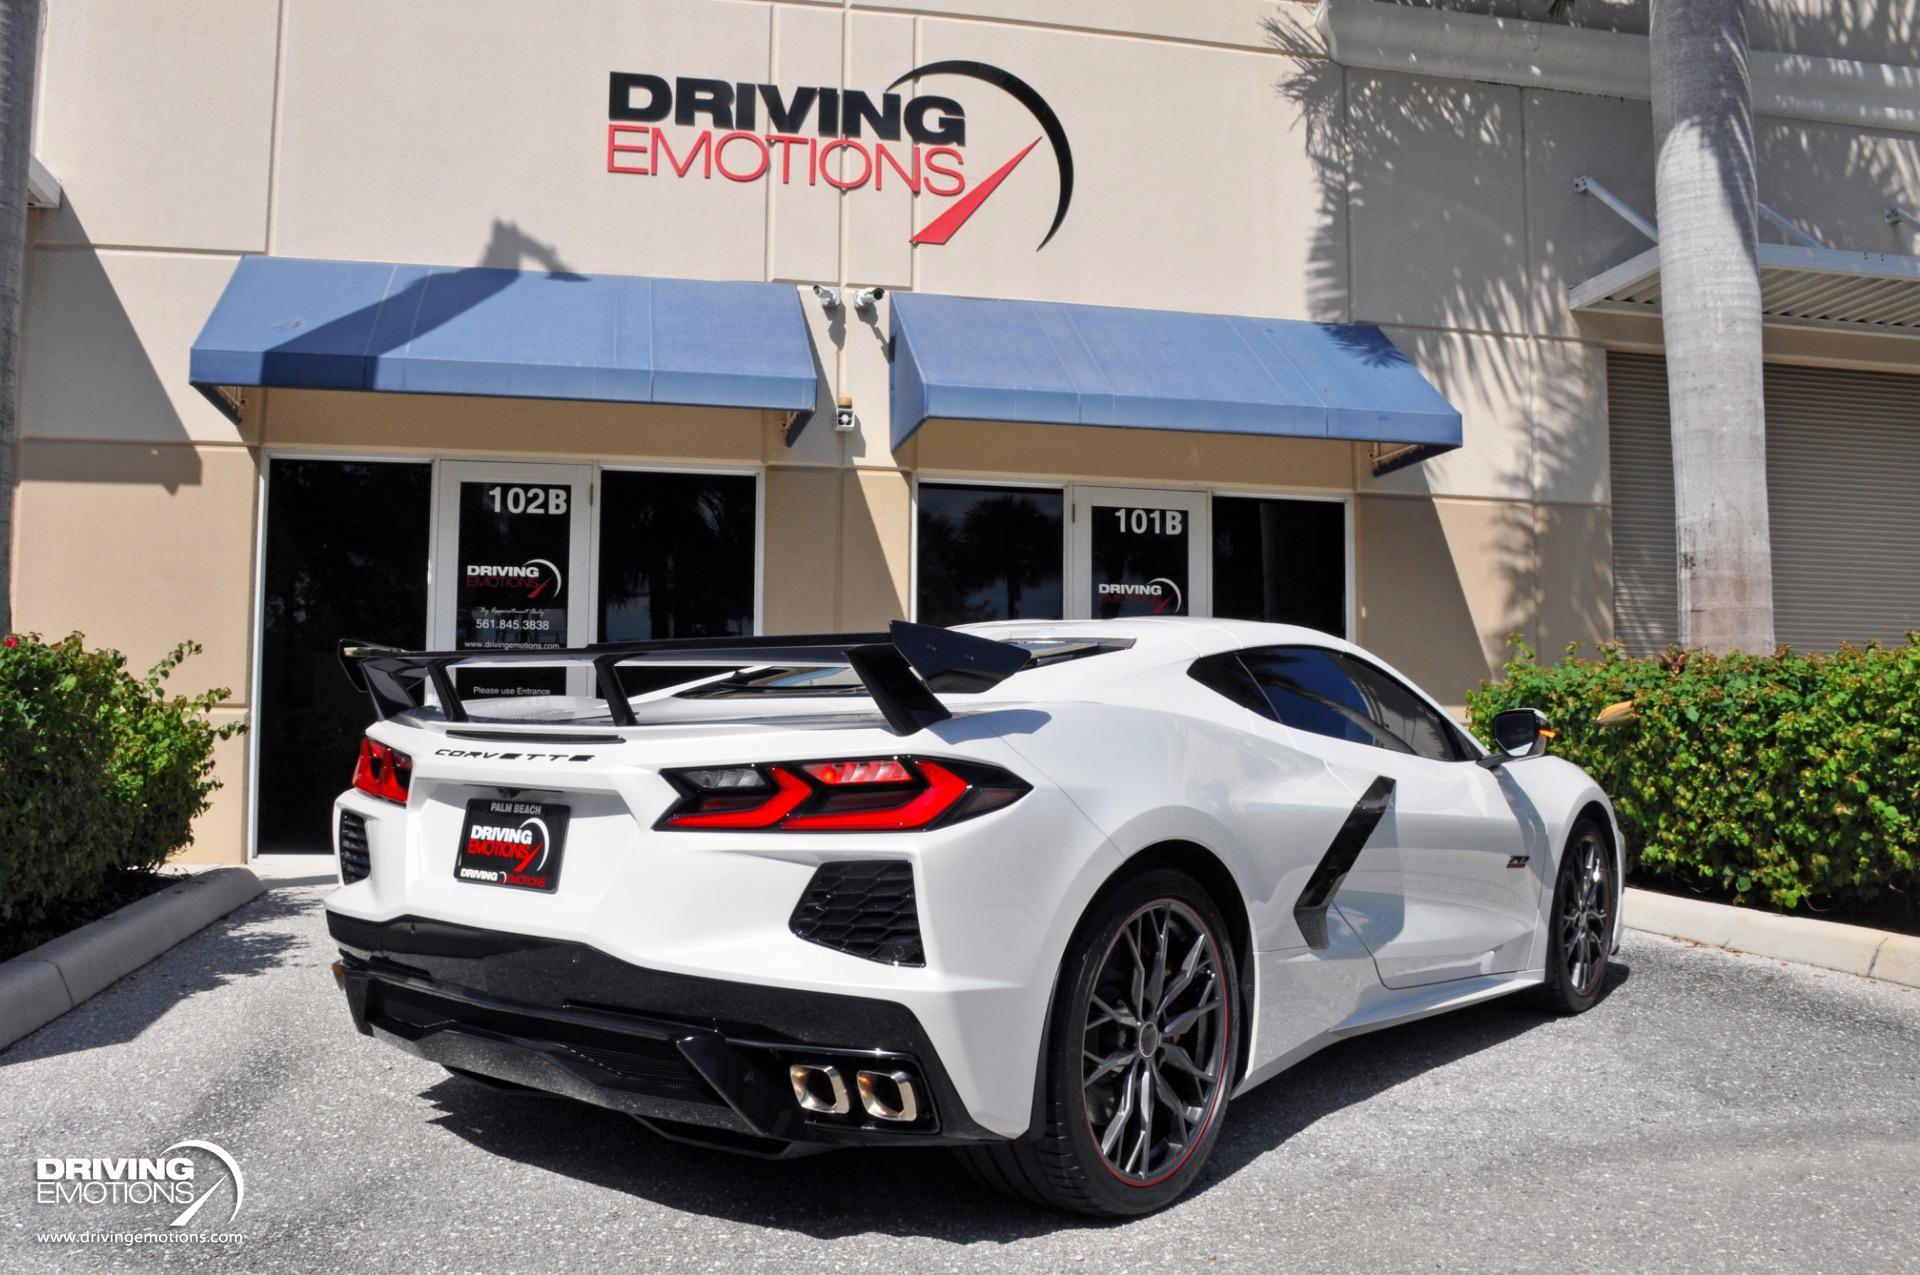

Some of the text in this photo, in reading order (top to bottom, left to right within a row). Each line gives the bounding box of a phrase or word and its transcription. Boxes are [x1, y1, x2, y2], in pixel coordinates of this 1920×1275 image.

[608, 71, 966, 147] DRIVING
[607, 124, 966, 197] EMOTIONS
[488, 486, 567, 515] 102B
[1114, 508, 1183, 535] 101B
[467, 565, 540, 577] DRIVING
[1098, 583, 1162, 595] DRIVING
[475, 619, 550, 630] 561.845.3838
[464, 641, 560, 650] www.drivingemotions.com
[473, 686, 499, 695] Please
[516, 687, 551, 696] Entrance
[434, 749, 595, 762] CORVETTE
[490, 802, 542, 815] PALM BEACH
[470, 824, 533, 845] DRIVING
[468, 838, 532, 859] EMOTIONS
[460, 868, 498, 882] DRIVING
